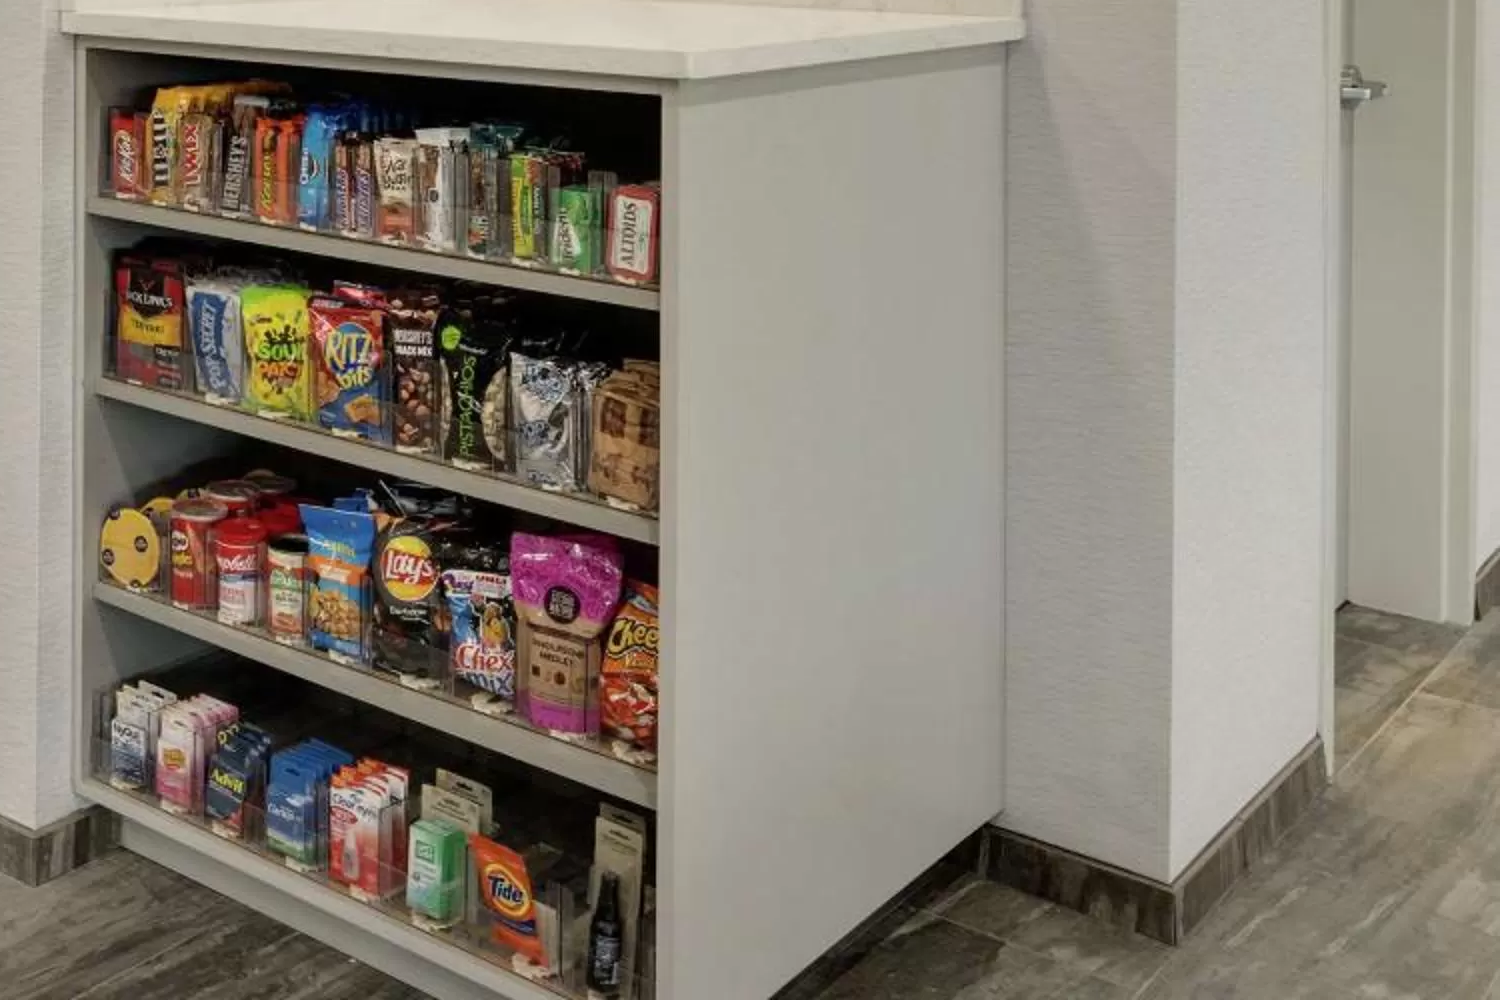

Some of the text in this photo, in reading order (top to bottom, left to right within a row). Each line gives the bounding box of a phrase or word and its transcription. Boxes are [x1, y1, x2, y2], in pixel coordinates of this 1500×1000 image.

[223, 134, 248, 210] HERSHEY'S
[619, 201, 638, 267] ALTOIDS
[324, 330, 374, 370] RITZ
[453, 641, 515, 672] Chex
[607, 616, 659, 658] Chee
[211, 769, 245, 793] Advil
[488, 874, 523, 903] Tide
